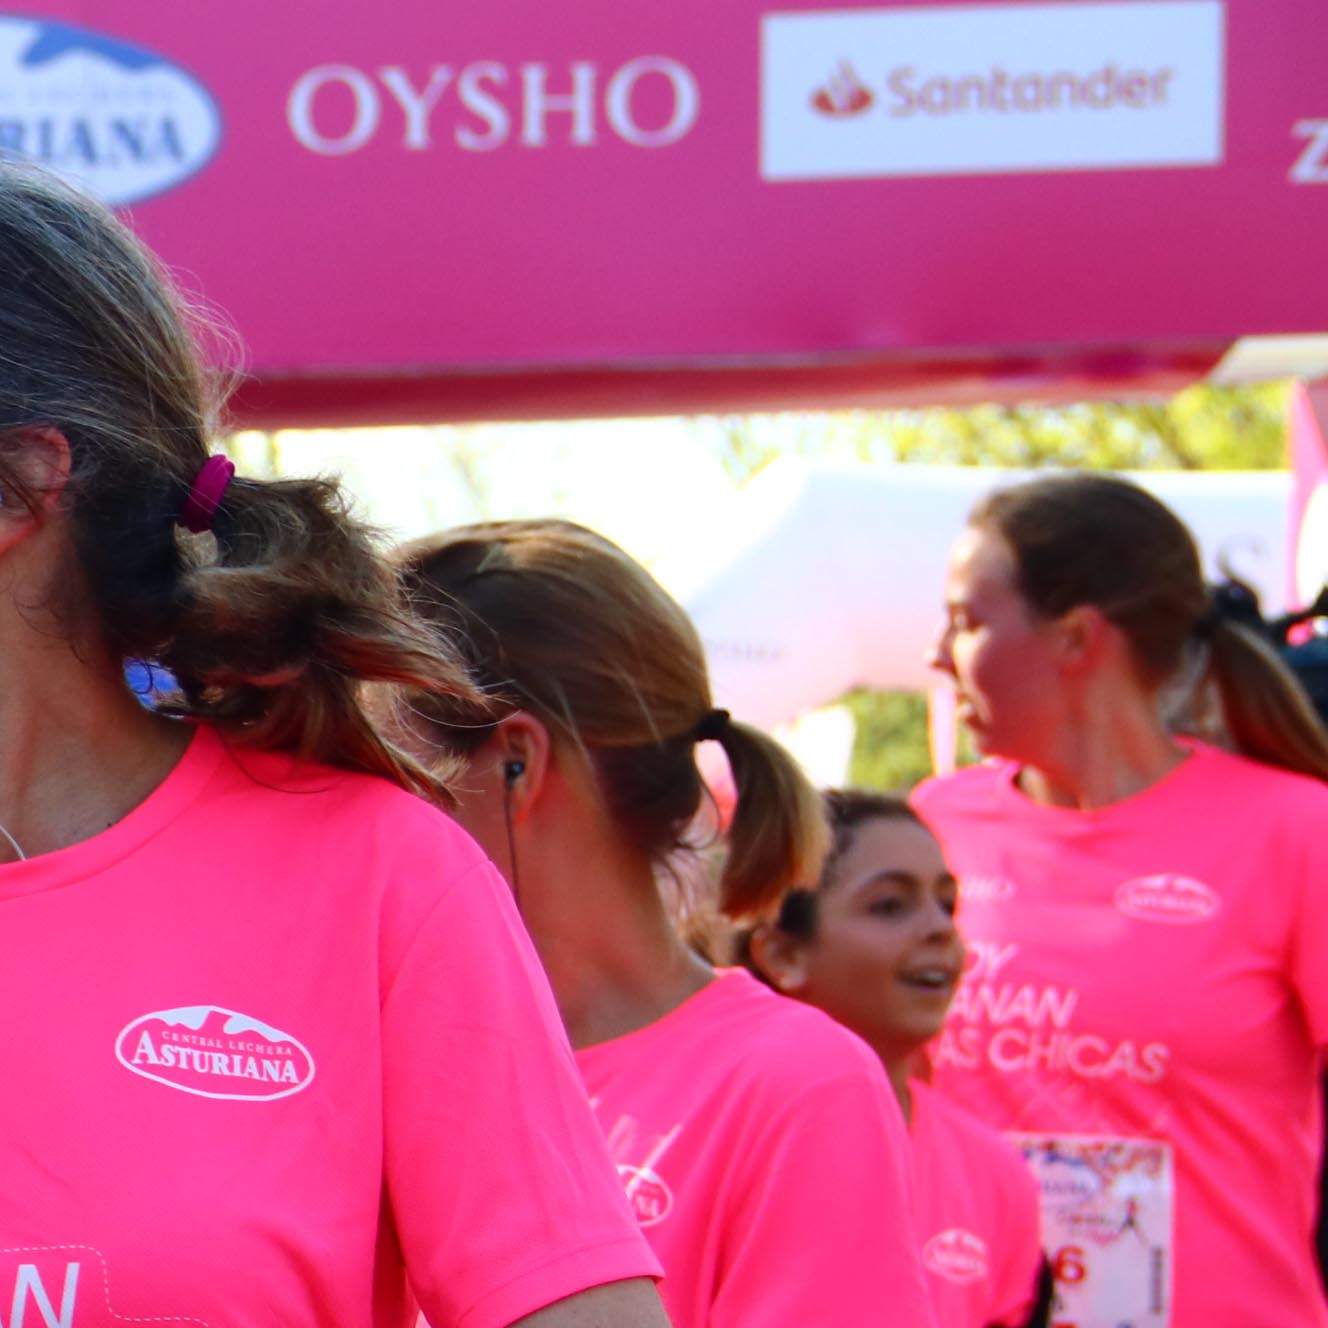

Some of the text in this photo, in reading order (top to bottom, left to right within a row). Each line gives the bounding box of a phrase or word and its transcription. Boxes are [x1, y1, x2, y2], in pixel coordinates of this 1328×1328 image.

[286, 56, 699, 156] OYSHO
[886, 59, 1176, 118] Santander
[130, 1029, 300, 1084] ASTURIANA
[161, 1030, 293, 1056] CENTRAL LECHERA
[988, 1028, 1171, 1083] CHICAS
[1055, 1245, 1088, 1286] 6
